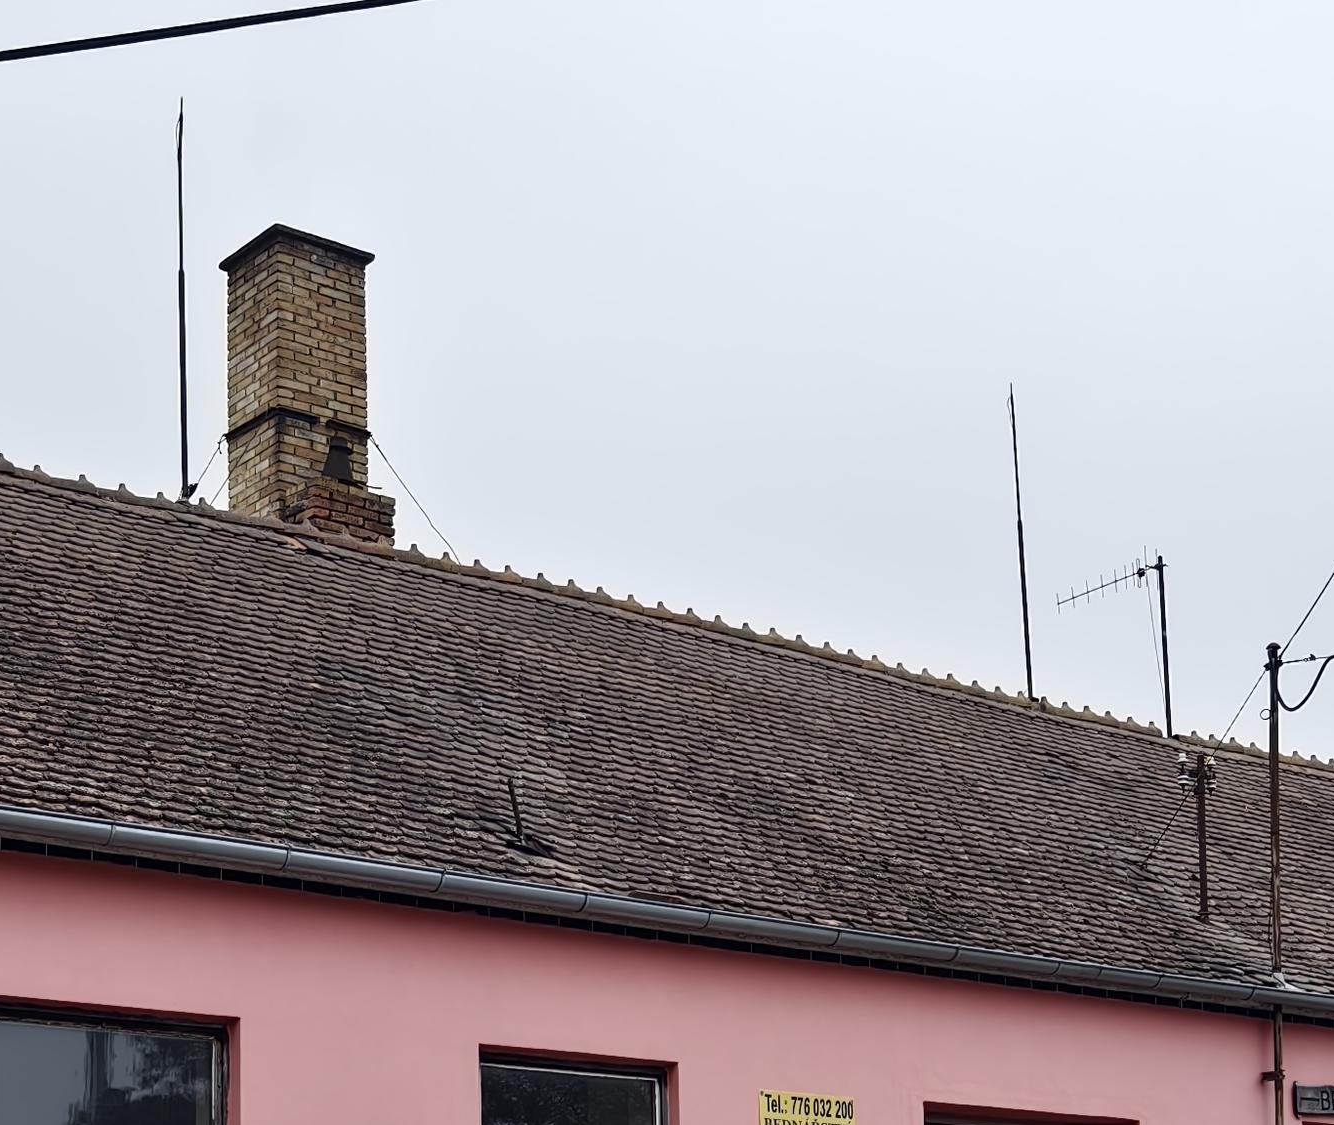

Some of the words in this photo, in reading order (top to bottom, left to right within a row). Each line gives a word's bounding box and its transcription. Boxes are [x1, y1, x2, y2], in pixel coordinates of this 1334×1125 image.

[764, 1094, 788, 1114] Tel.:
[791, 1096, 810, 1116] 776
[813, 1098, 832, 1118] 032
[835, 1101, 854, 1120] 200
